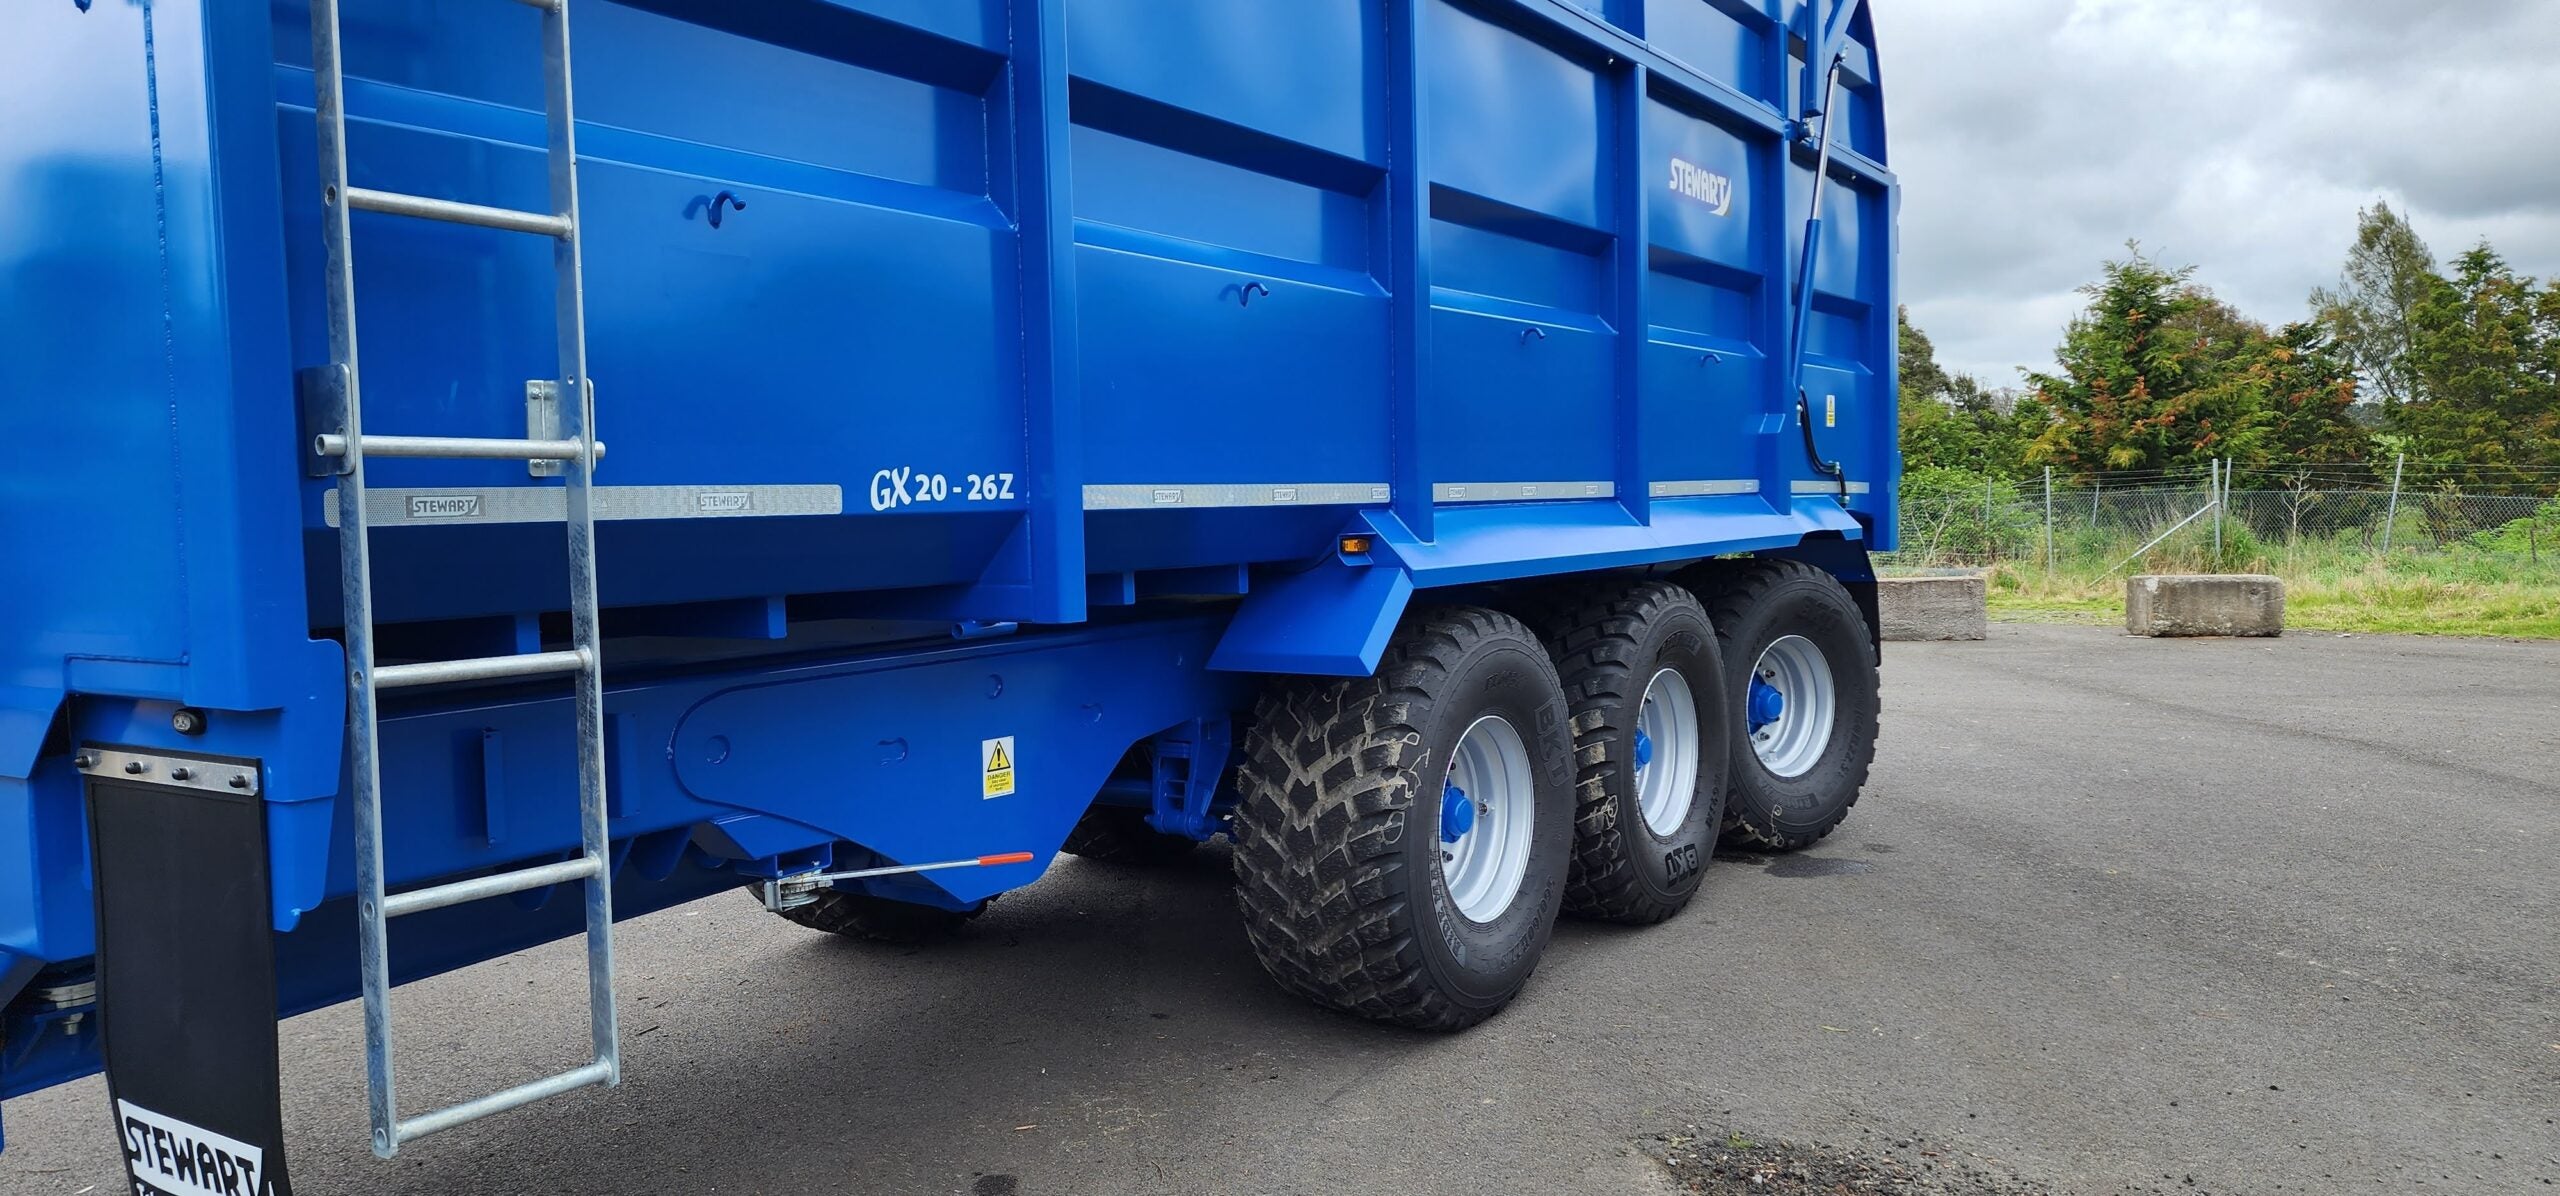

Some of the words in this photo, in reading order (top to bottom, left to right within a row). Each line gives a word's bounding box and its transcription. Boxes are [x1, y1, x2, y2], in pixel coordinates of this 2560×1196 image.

[1669, 157, 1730, 212] STEWART
[413, 499, 475, 514] STEWART
[701, 495, 747, 508] STEWART
[870, 466, 912, 511] GX
[915, 473, 948, 501] 20
[967, 473, 1014, 500] 26Z
[1536, 700, 1570, 786] BKT
[987, 771, 1011, 780] DANGER
[1665, 844, 1699, 888] BKT
[125, 1115, 256, 1196] STEWART
